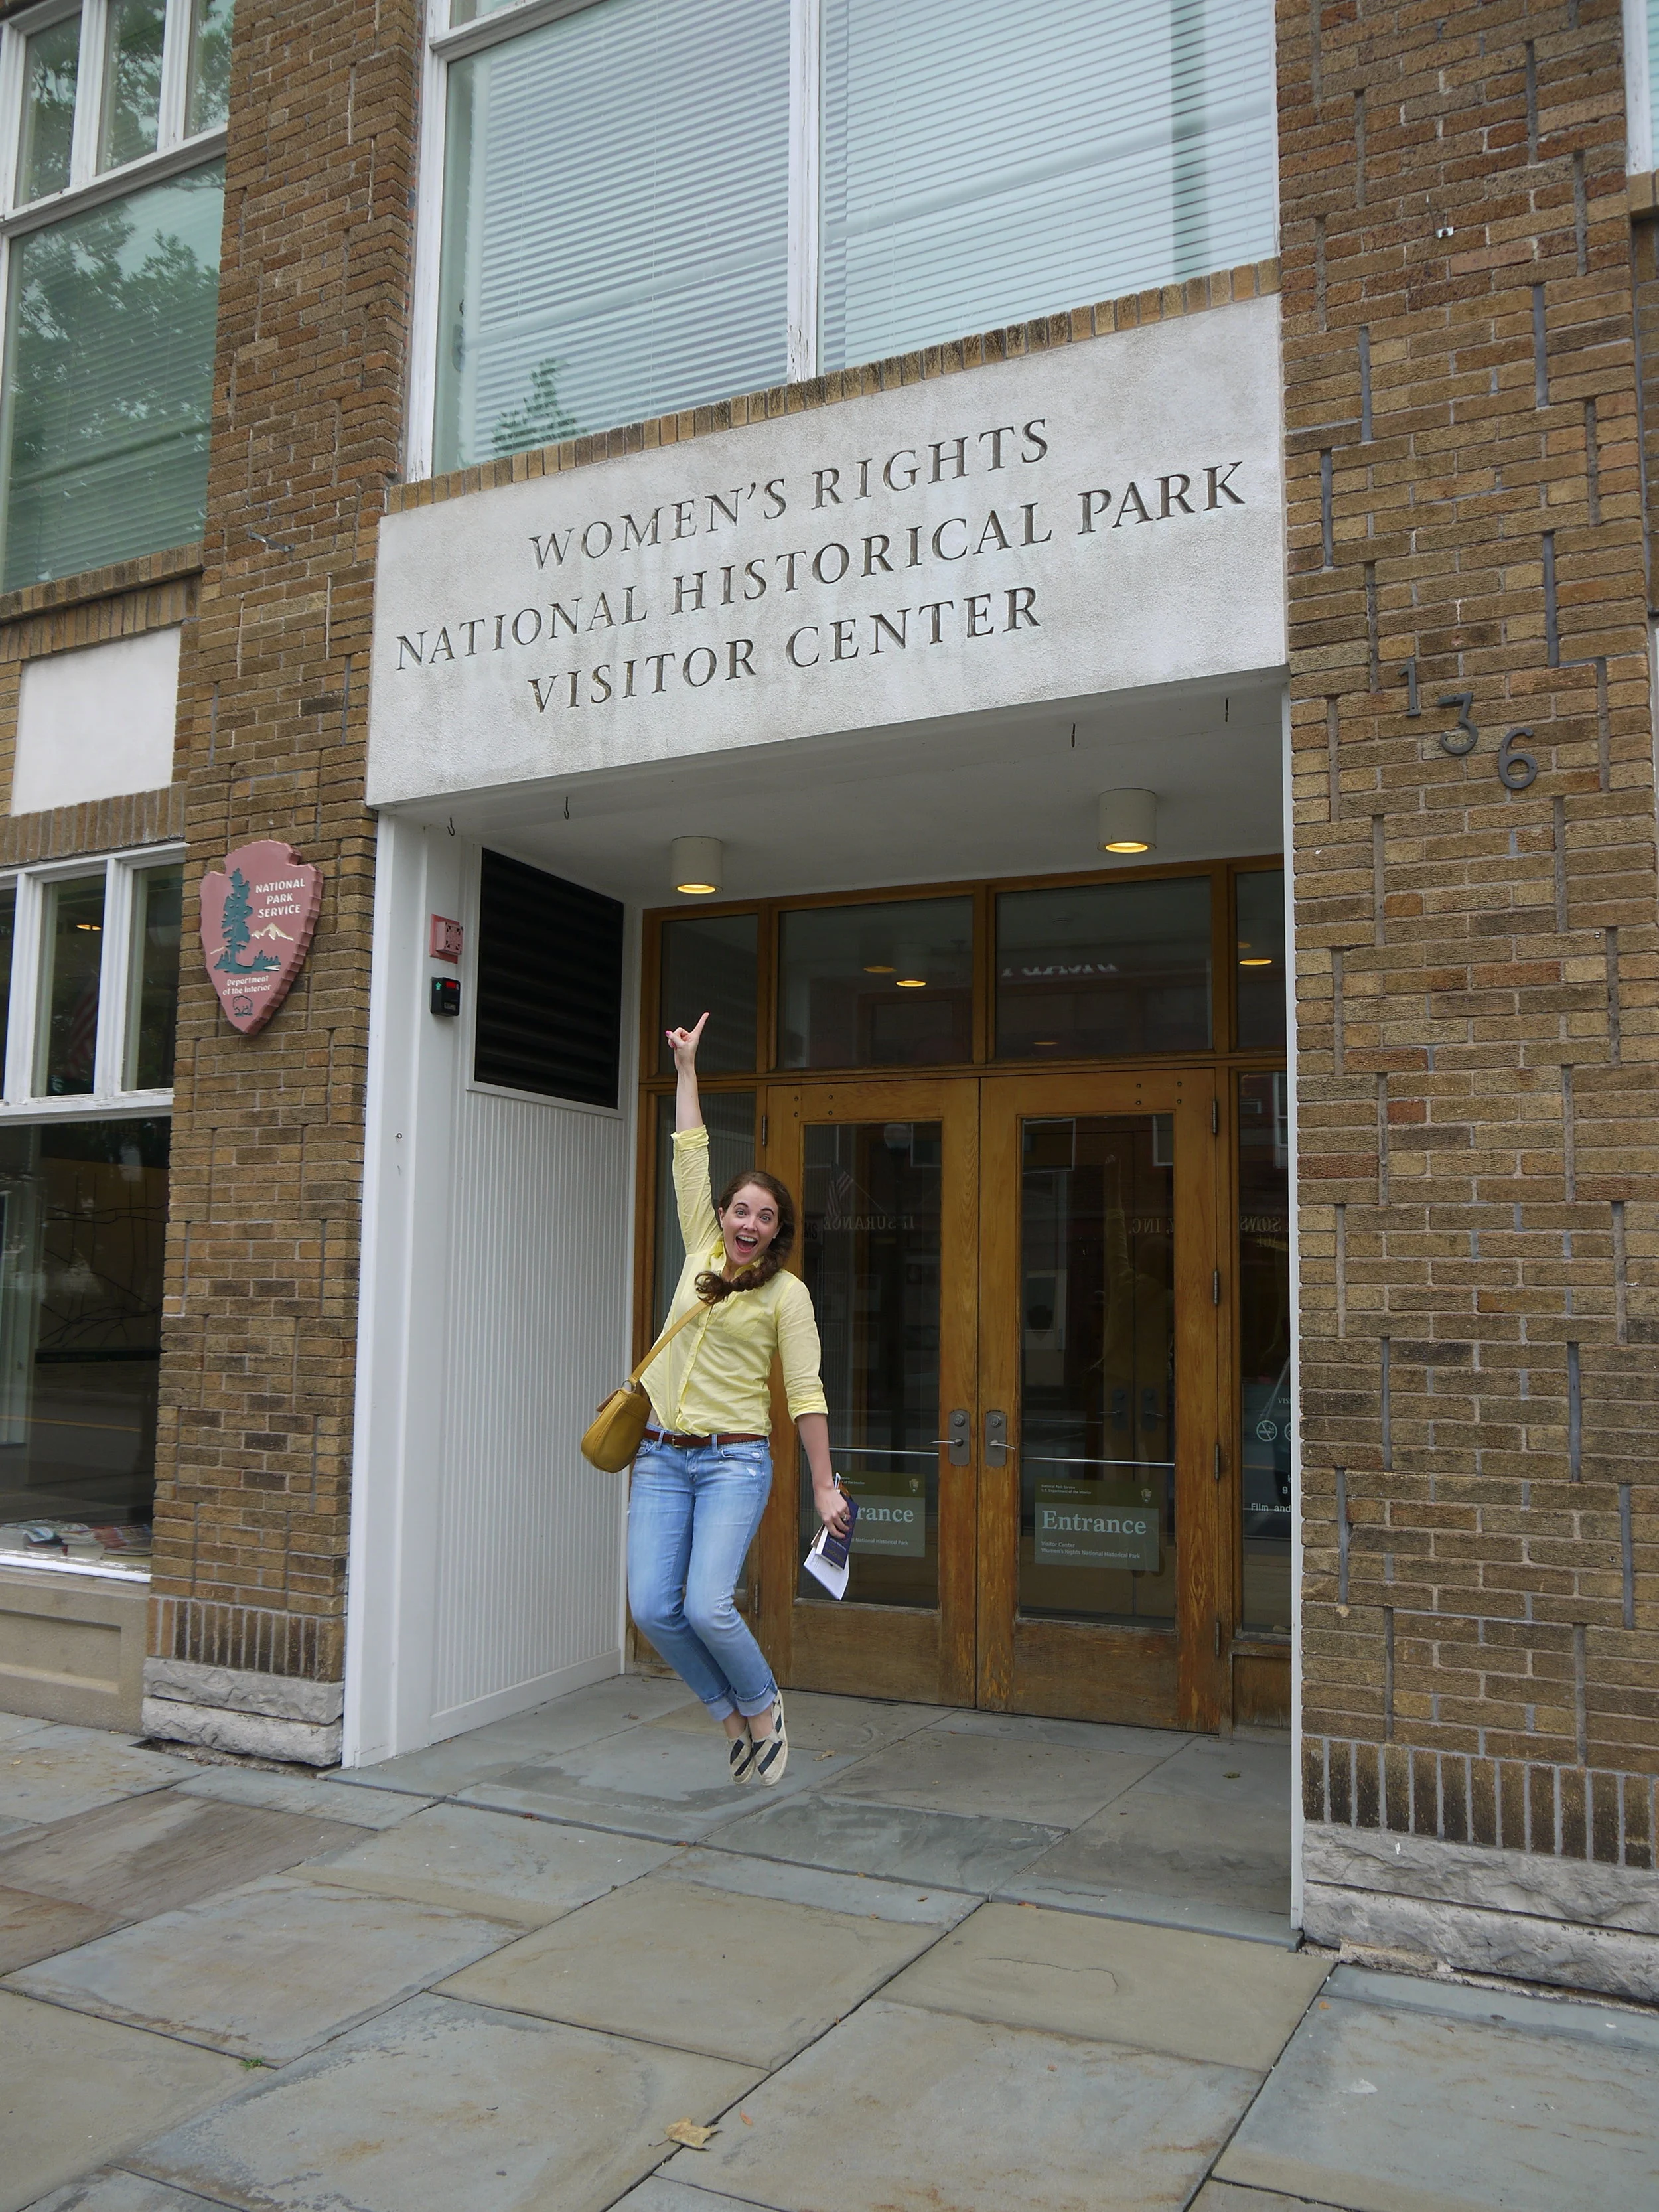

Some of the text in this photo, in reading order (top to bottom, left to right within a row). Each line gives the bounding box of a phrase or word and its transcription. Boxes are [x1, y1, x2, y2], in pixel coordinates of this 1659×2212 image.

[530, 417, 1048, 570] WOMEN'S RIGHTS
[396, 460, 1246, 670] NATIONAL HISTORICAL PARK
[528, 585, 1041, 714] VISITOR CENTER
[255, 878, 305, 893] NATIONAL
[267, 893, 293, 905] PARK
[257, 904, 301, 918] SERVICE
[226, 975, 269, 987] Department
[244, 984, 271, 994] Interior
[1251, 1503, 1269, 1511] Film
[856, 1507, 914, 1523] rance
[1041, 1510, 1147, 1535] Entrance
